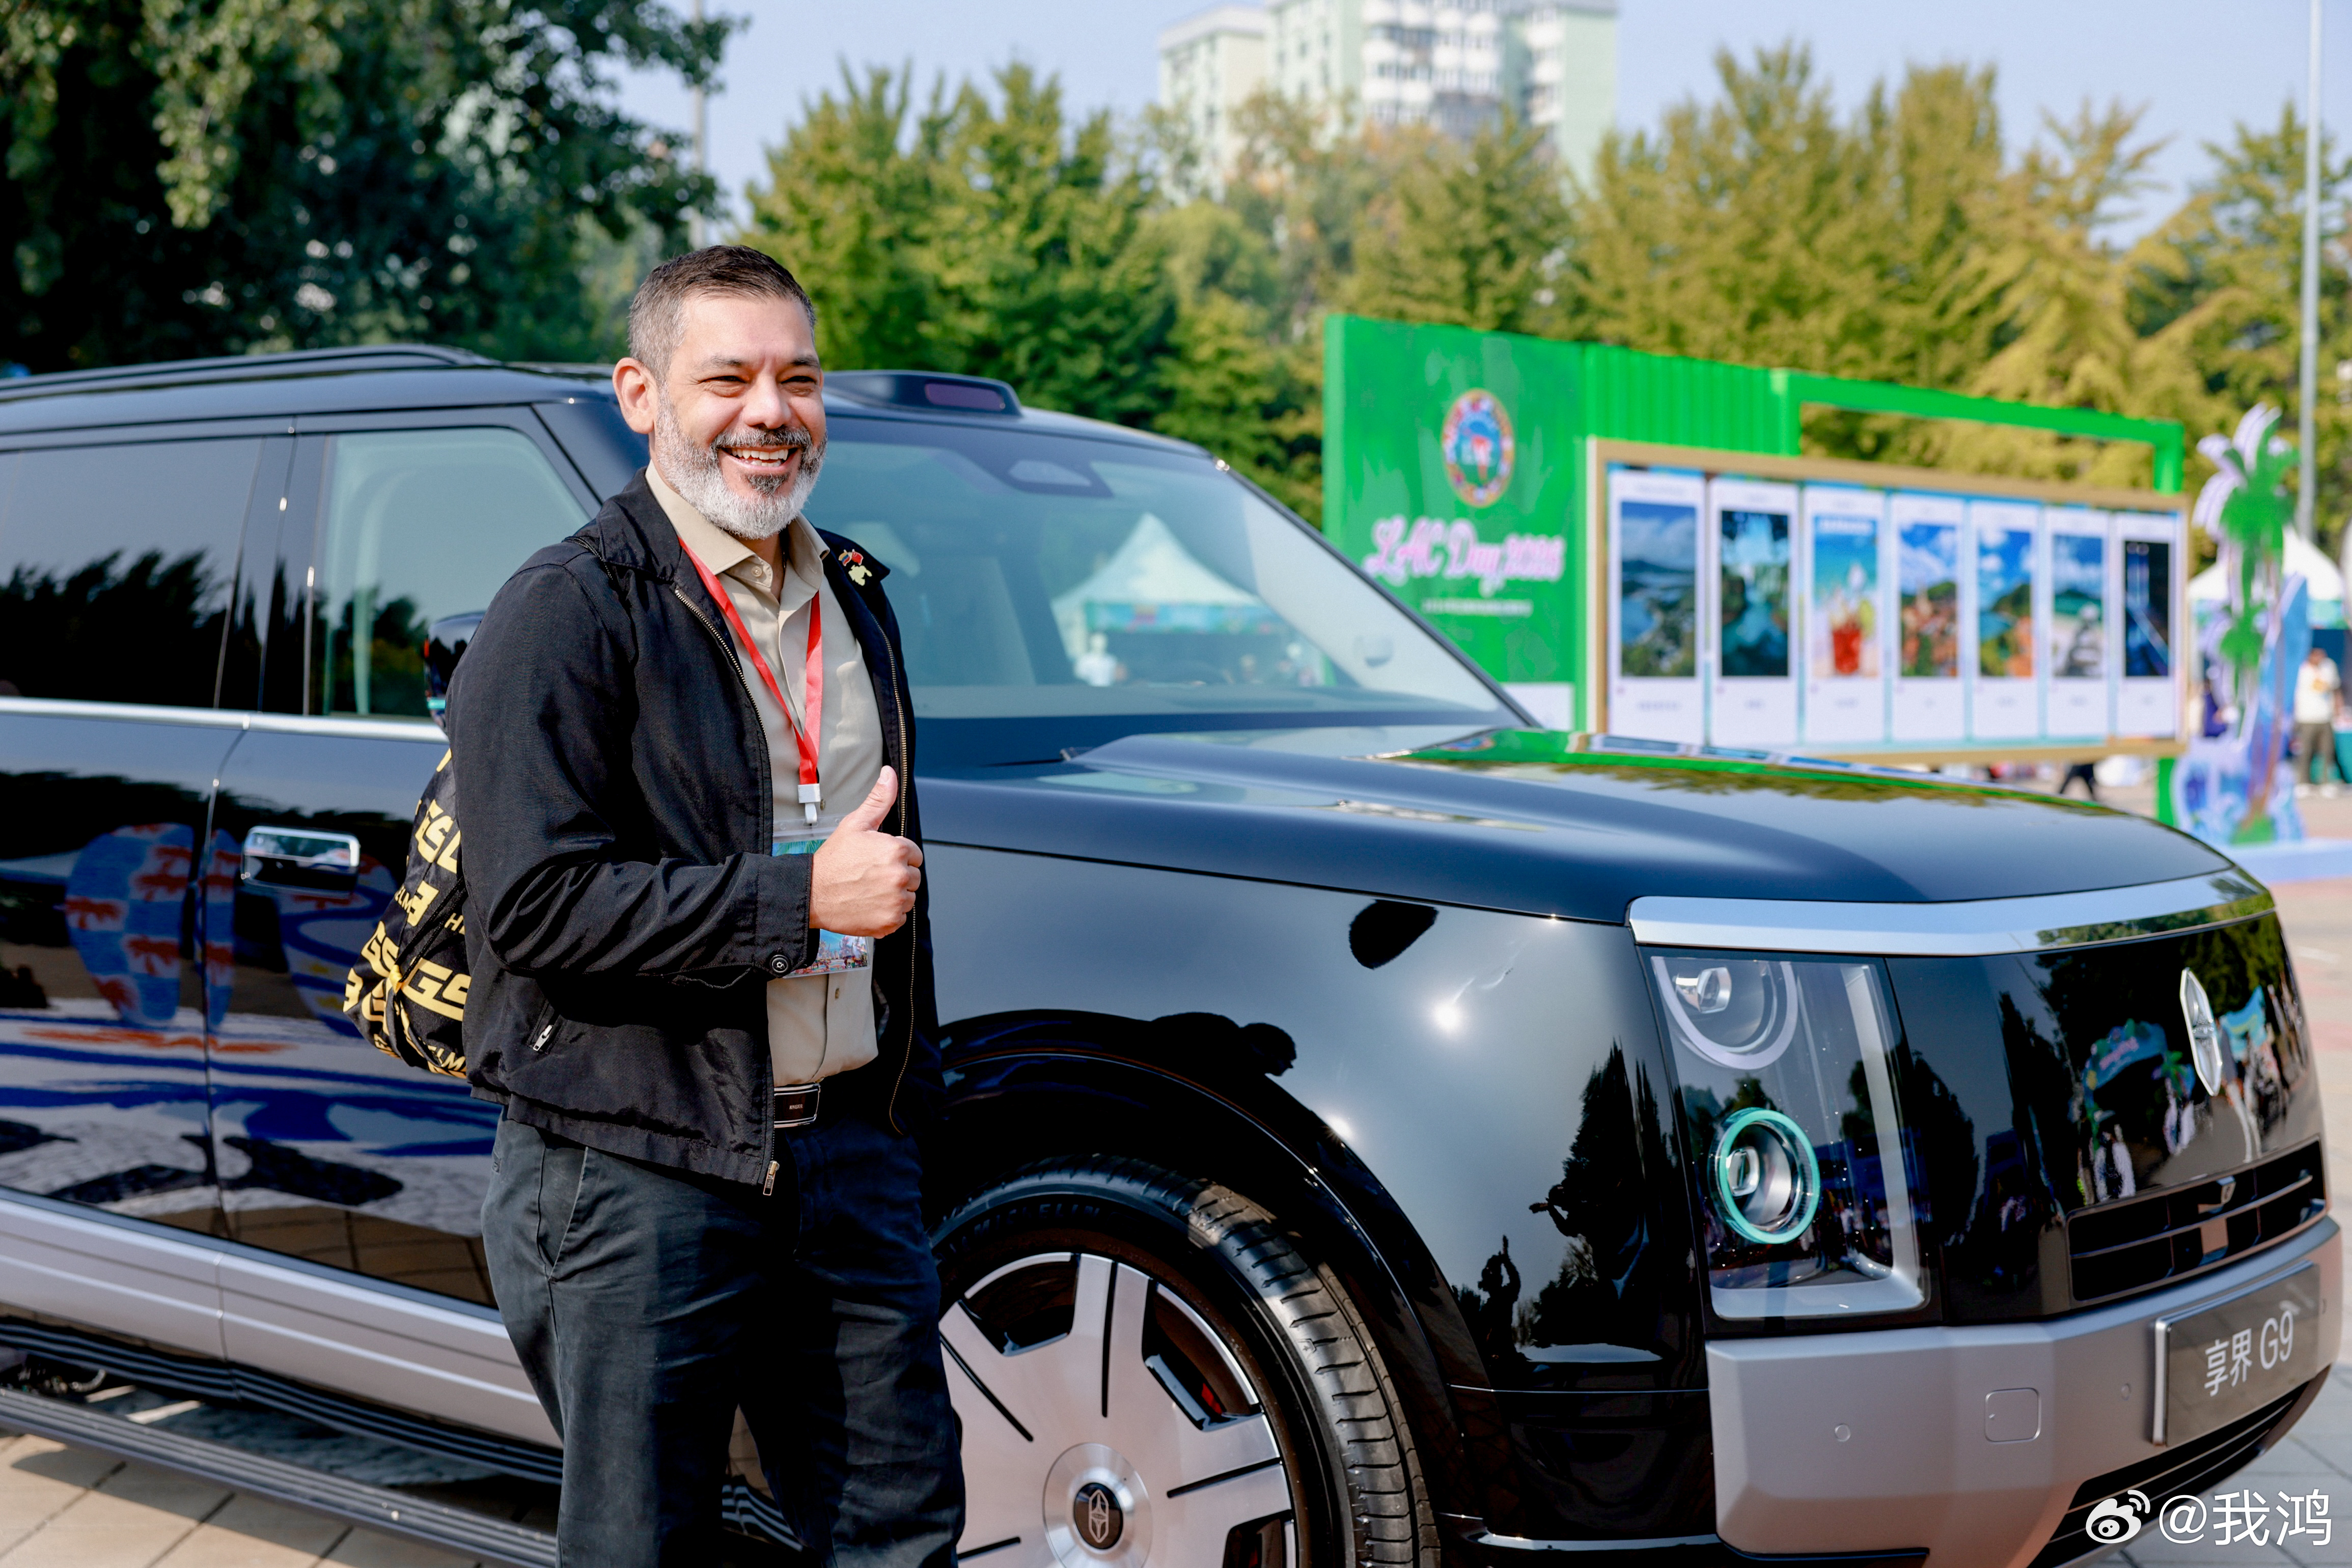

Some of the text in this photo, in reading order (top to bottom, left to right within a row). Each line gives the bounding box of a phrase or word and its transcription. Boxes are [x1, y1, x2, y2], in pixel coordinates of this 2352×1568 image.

[1444, 518, 1505, 597] Day
[2204, 1310, 2294, 1397] 享界 G9
